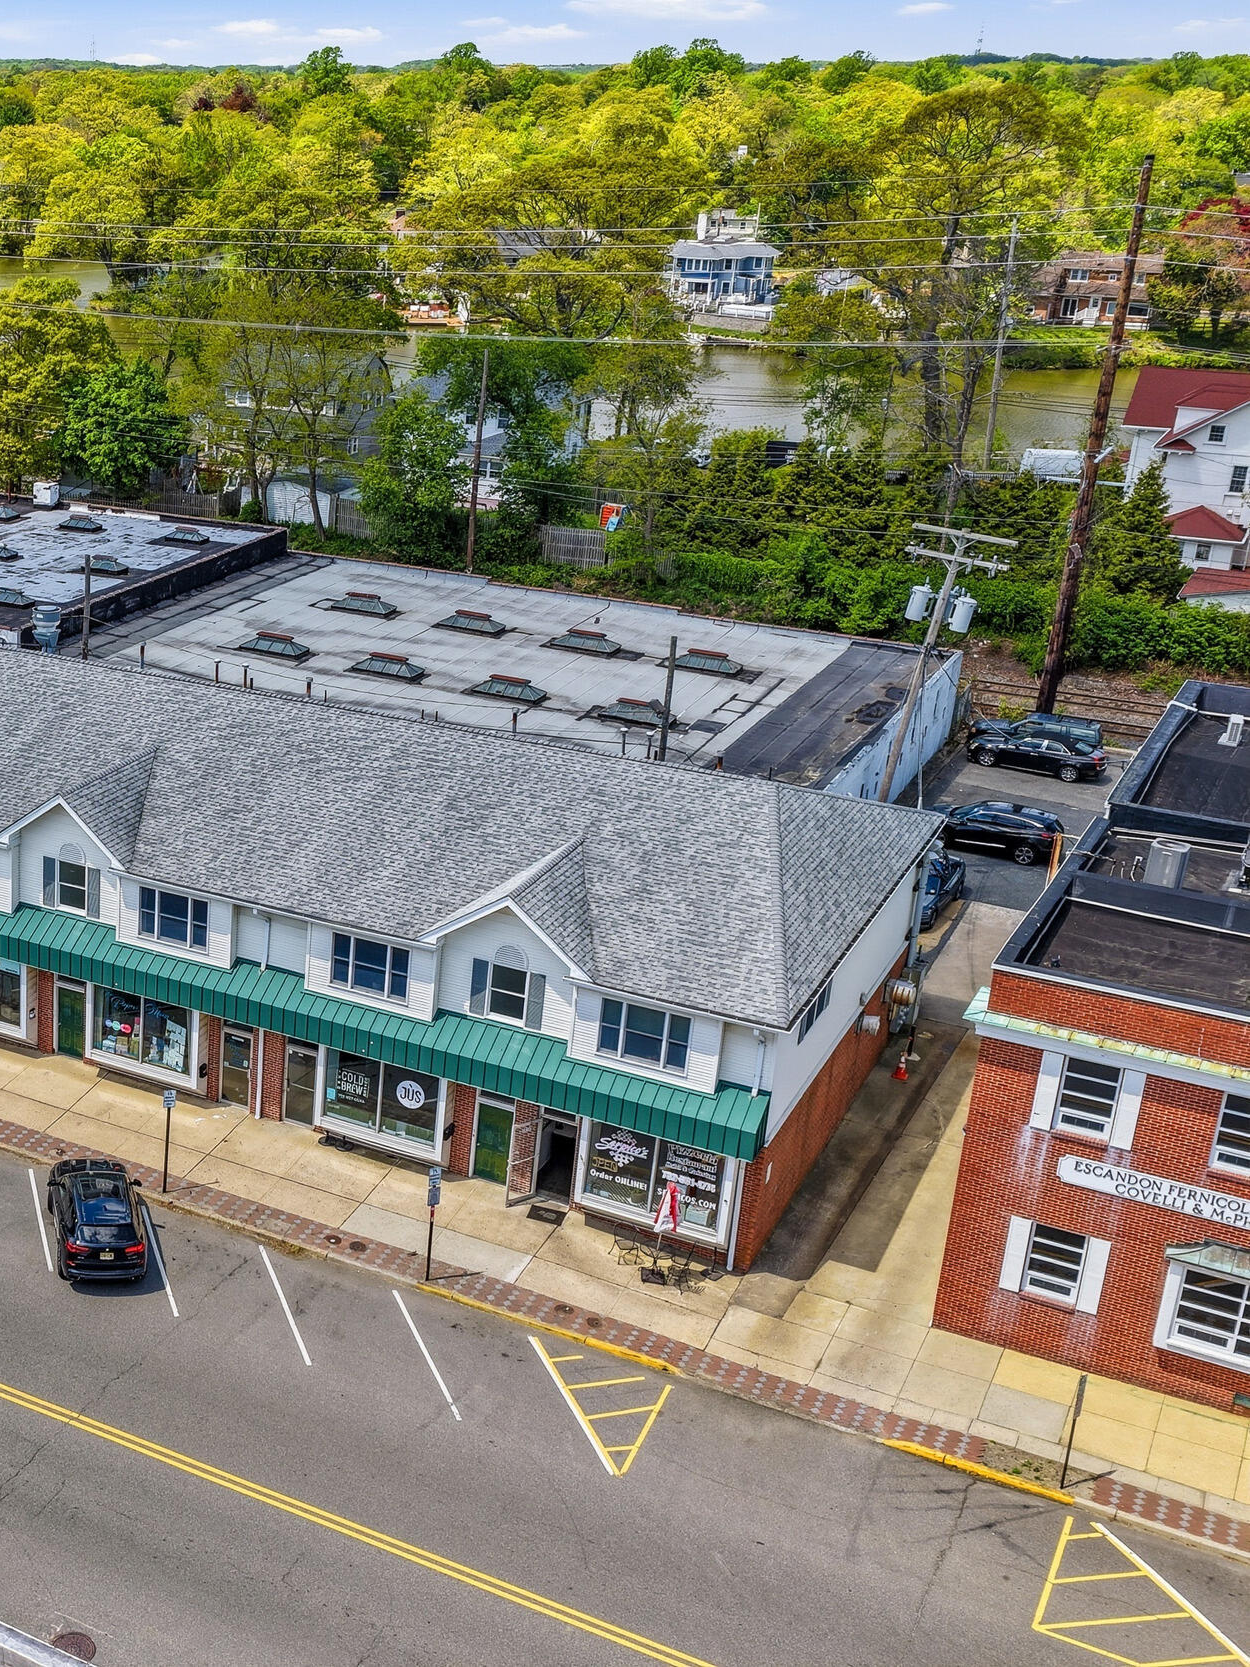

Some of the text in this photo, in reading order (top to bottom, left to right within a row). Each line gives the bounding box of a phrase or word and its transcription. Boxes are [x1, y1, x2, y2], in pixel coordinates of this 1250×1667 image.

[341, 1071, 364, 1086] COLD
[341, 1081, 364, 1095] BREW
[399, 1083, 422, 1104] JÙS
[590, 1168, 614, 1181] Order
[1073, 1159, 1163, 1193] ESCANDON
[1114, 1182, 1187, 1211] COVELLI
[1192, 1203, 1204, 1215] &
